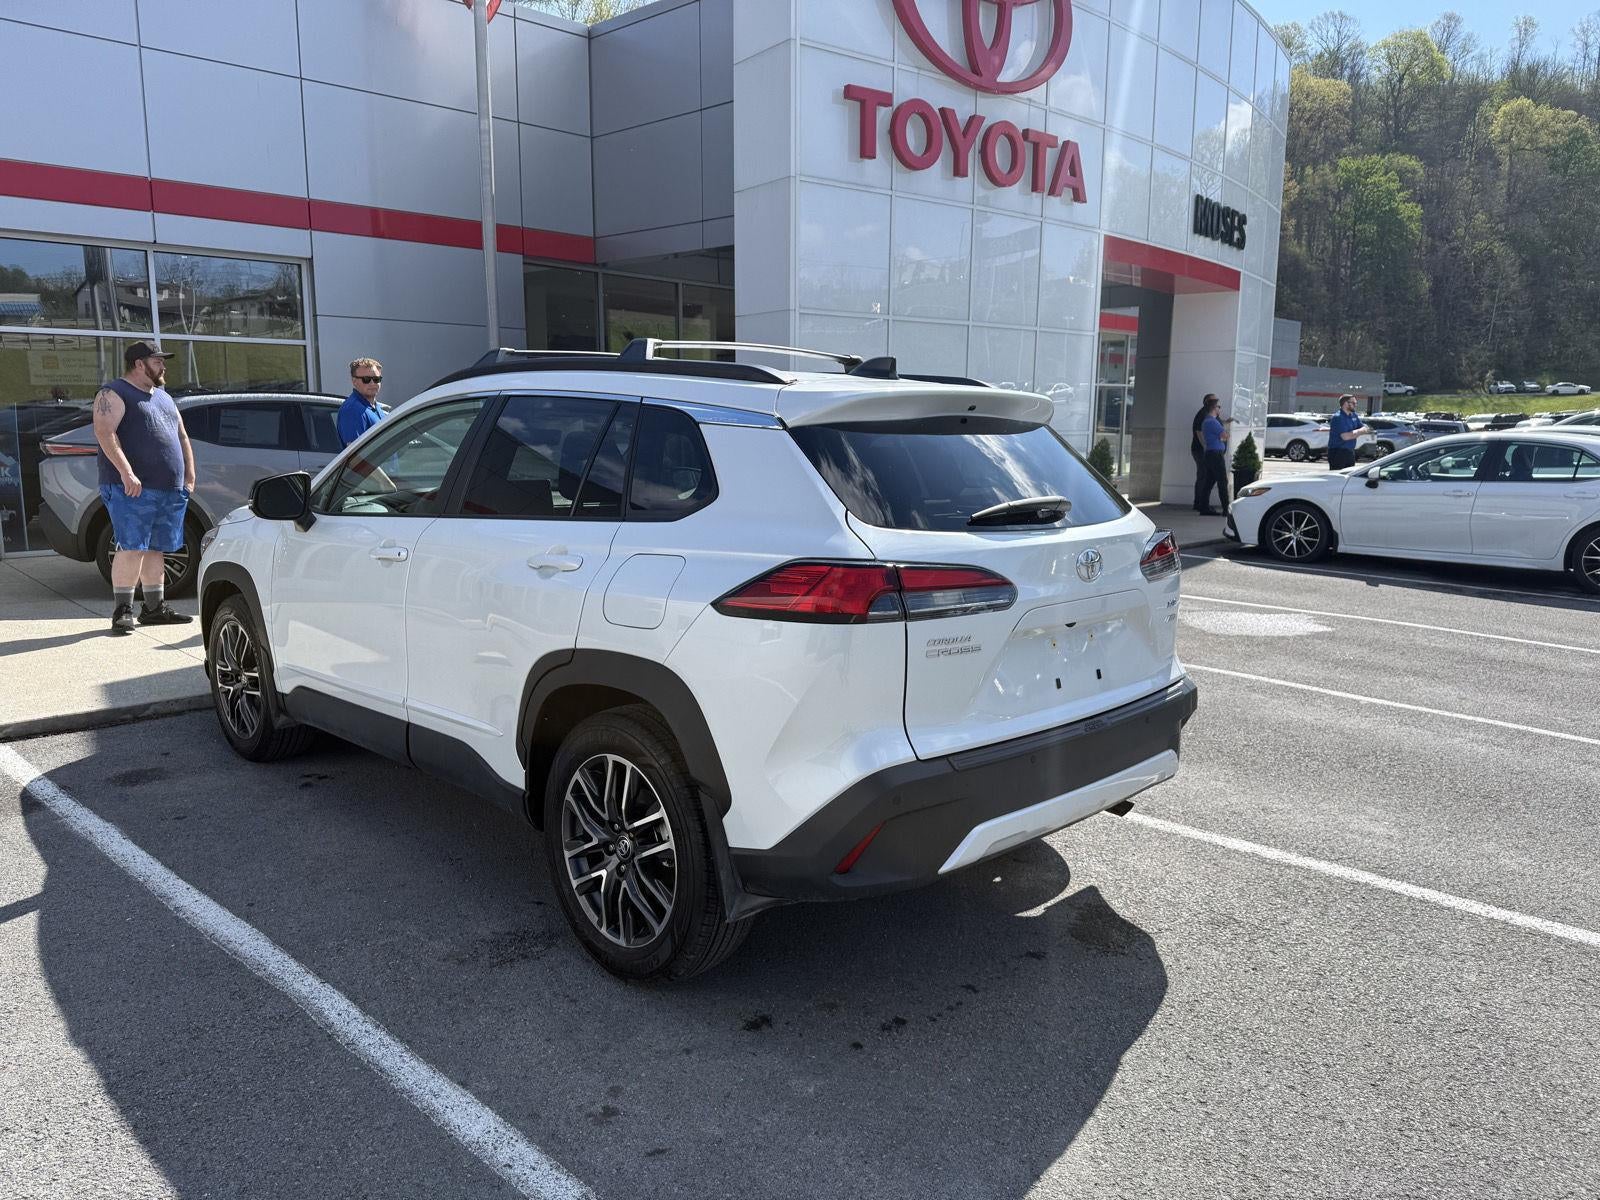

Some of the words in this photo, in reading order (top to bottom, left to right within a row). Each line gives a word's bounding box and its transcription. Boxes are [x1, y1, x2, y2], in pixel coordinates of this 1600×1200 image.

[843, 84, 1087, 203] TOYOTA
[1193, 194, 1247, 250] MOSES
[926, 644, 982, 658] CROSS
